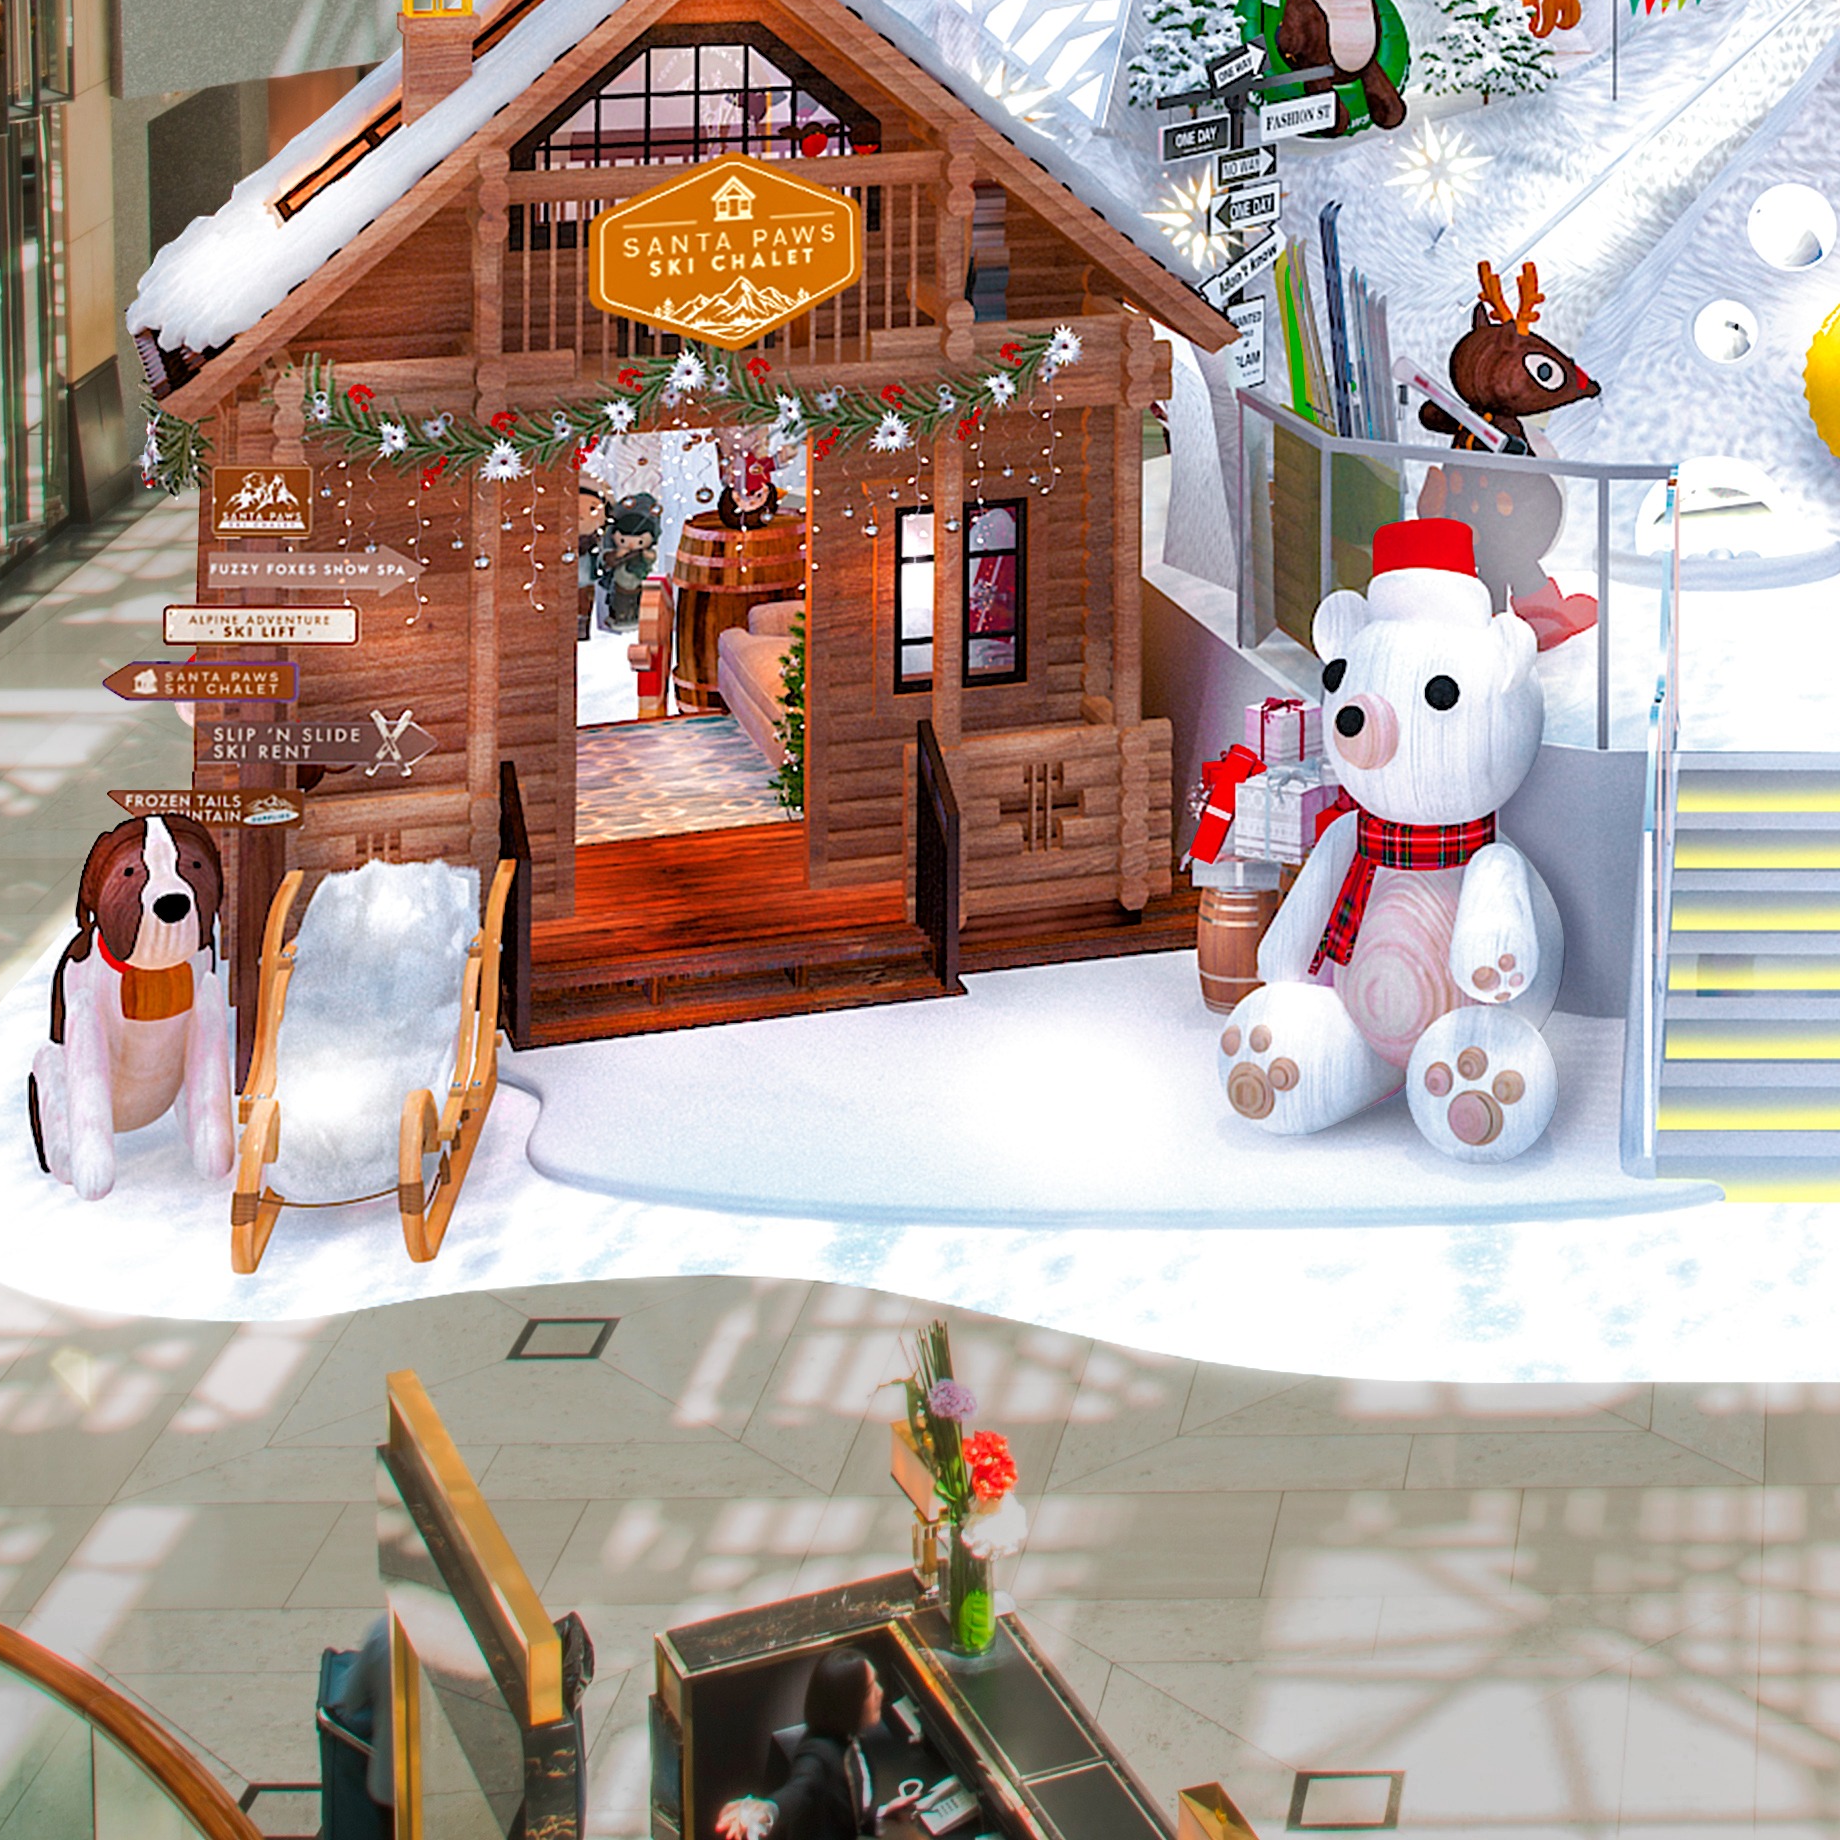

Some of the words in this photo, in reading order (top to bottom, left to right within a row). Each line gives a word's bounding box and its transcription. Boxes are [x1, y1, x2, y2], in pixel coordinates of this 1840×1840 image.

[1218, 65, 1235, 82] ONE
[1235, 56, 1252, 73] WAY
[1266, 109, 1315, 131] FASHION
[1317, 105, 1332, 121] ST
[1175, 130, 1196, 149] ONE
[1198, 125, 1217, 144] DAY
[1224, 161, 1238, 174] NO
[1230, 202, 1251, 220] ONE
[1253, 194, 1275, 213] DAY
[623, 231, 732, 258] SANTA
[752, 223, 836, 248] PAWS
[649, 257, 695, 277] SKI
[711, 247, 814, 272] CHALET
[1250, 243, 1278, 273] know
[223, 512, 262, 521] SANTA
[270, 512, 302, 521] PAWS
[210, 564, 259, 575] FUZZY
[266, 564, 316, 575] FOXES
[323, 564, 371, 575] SNOW
[377, 564, 407, 576] SPA
[188, 615, 238, 625] ALPINE
[245, 615, 330, 626] ADVENTURE
[223, 626, 253, 638] SKI
[262, 626, 296, 638] LIFT
[164, 671, 220, 683] SANTA
[231, 671, 279, 683] PAWS
[164, 683, 196, 695] SKI
[206, 683, 278, 695] CHALET
[213, 728, 255, 742] SLIP
[267, 728, 291, 742] 'N
[301, 727, 361, 742] SLIDE
[213, 744, 247, 759] SKI
[259, 744, 312, 759] RENT
[124, 794, 191, 808] FROZEN
[197, 794, 243, 808] TAILS
